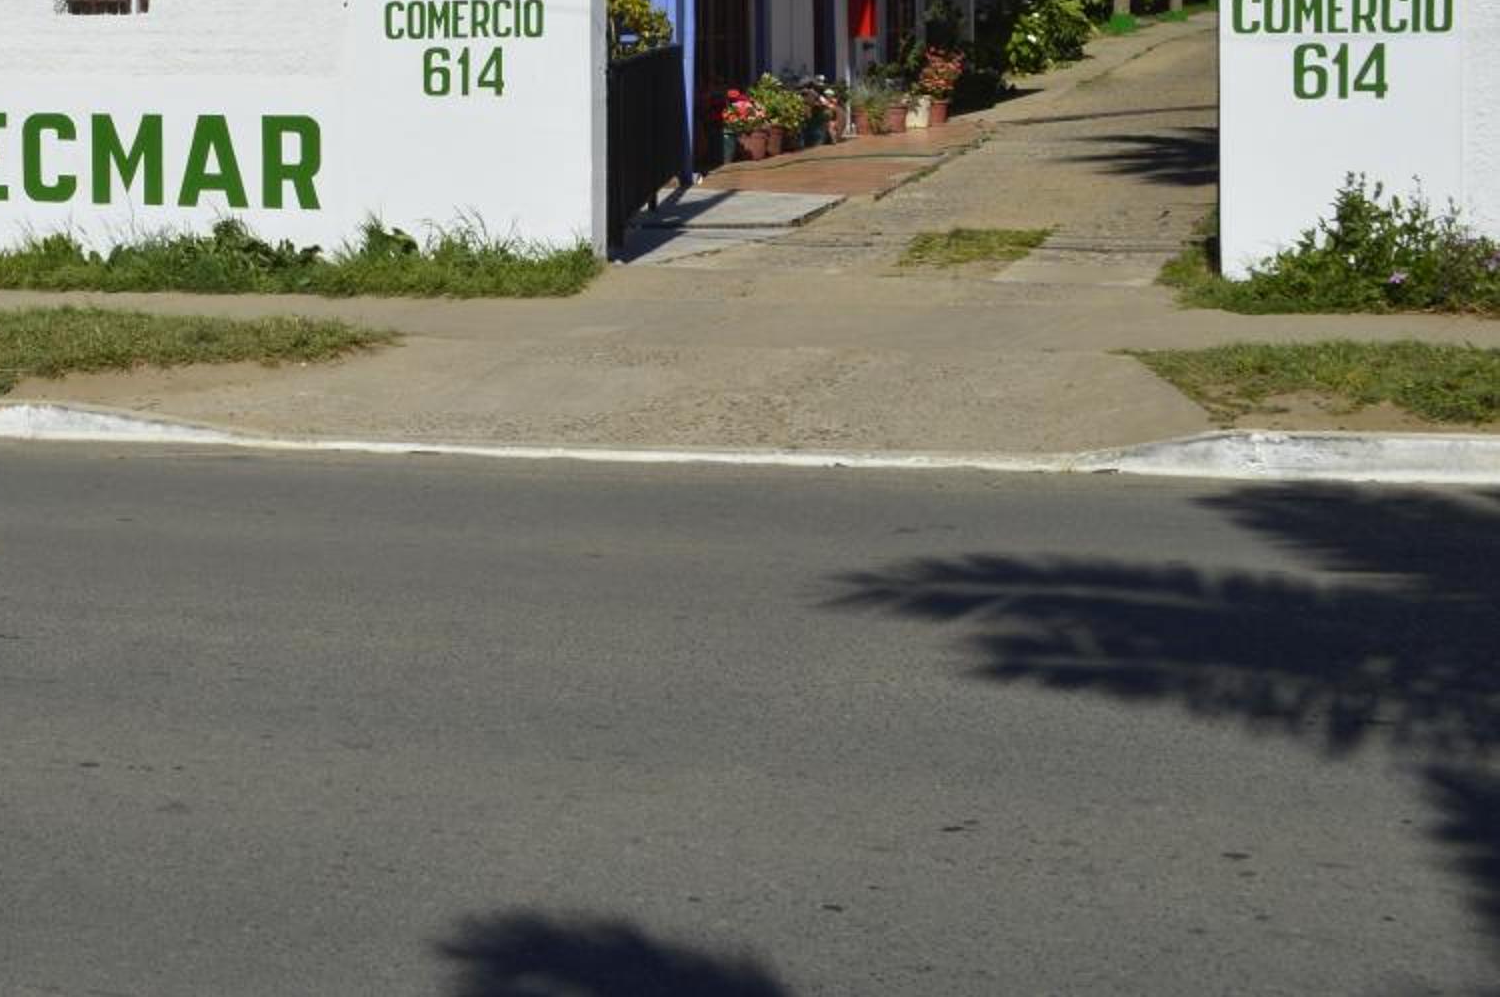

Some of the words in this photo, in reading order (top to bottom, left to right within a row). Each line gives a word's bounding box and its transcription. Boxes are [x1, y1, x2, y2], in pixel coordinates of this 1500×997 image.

[385, 0, 545, 40] COMERCIO
[423, 46, 506, 97] 614
[1293, 42, 1389, 100] 614
